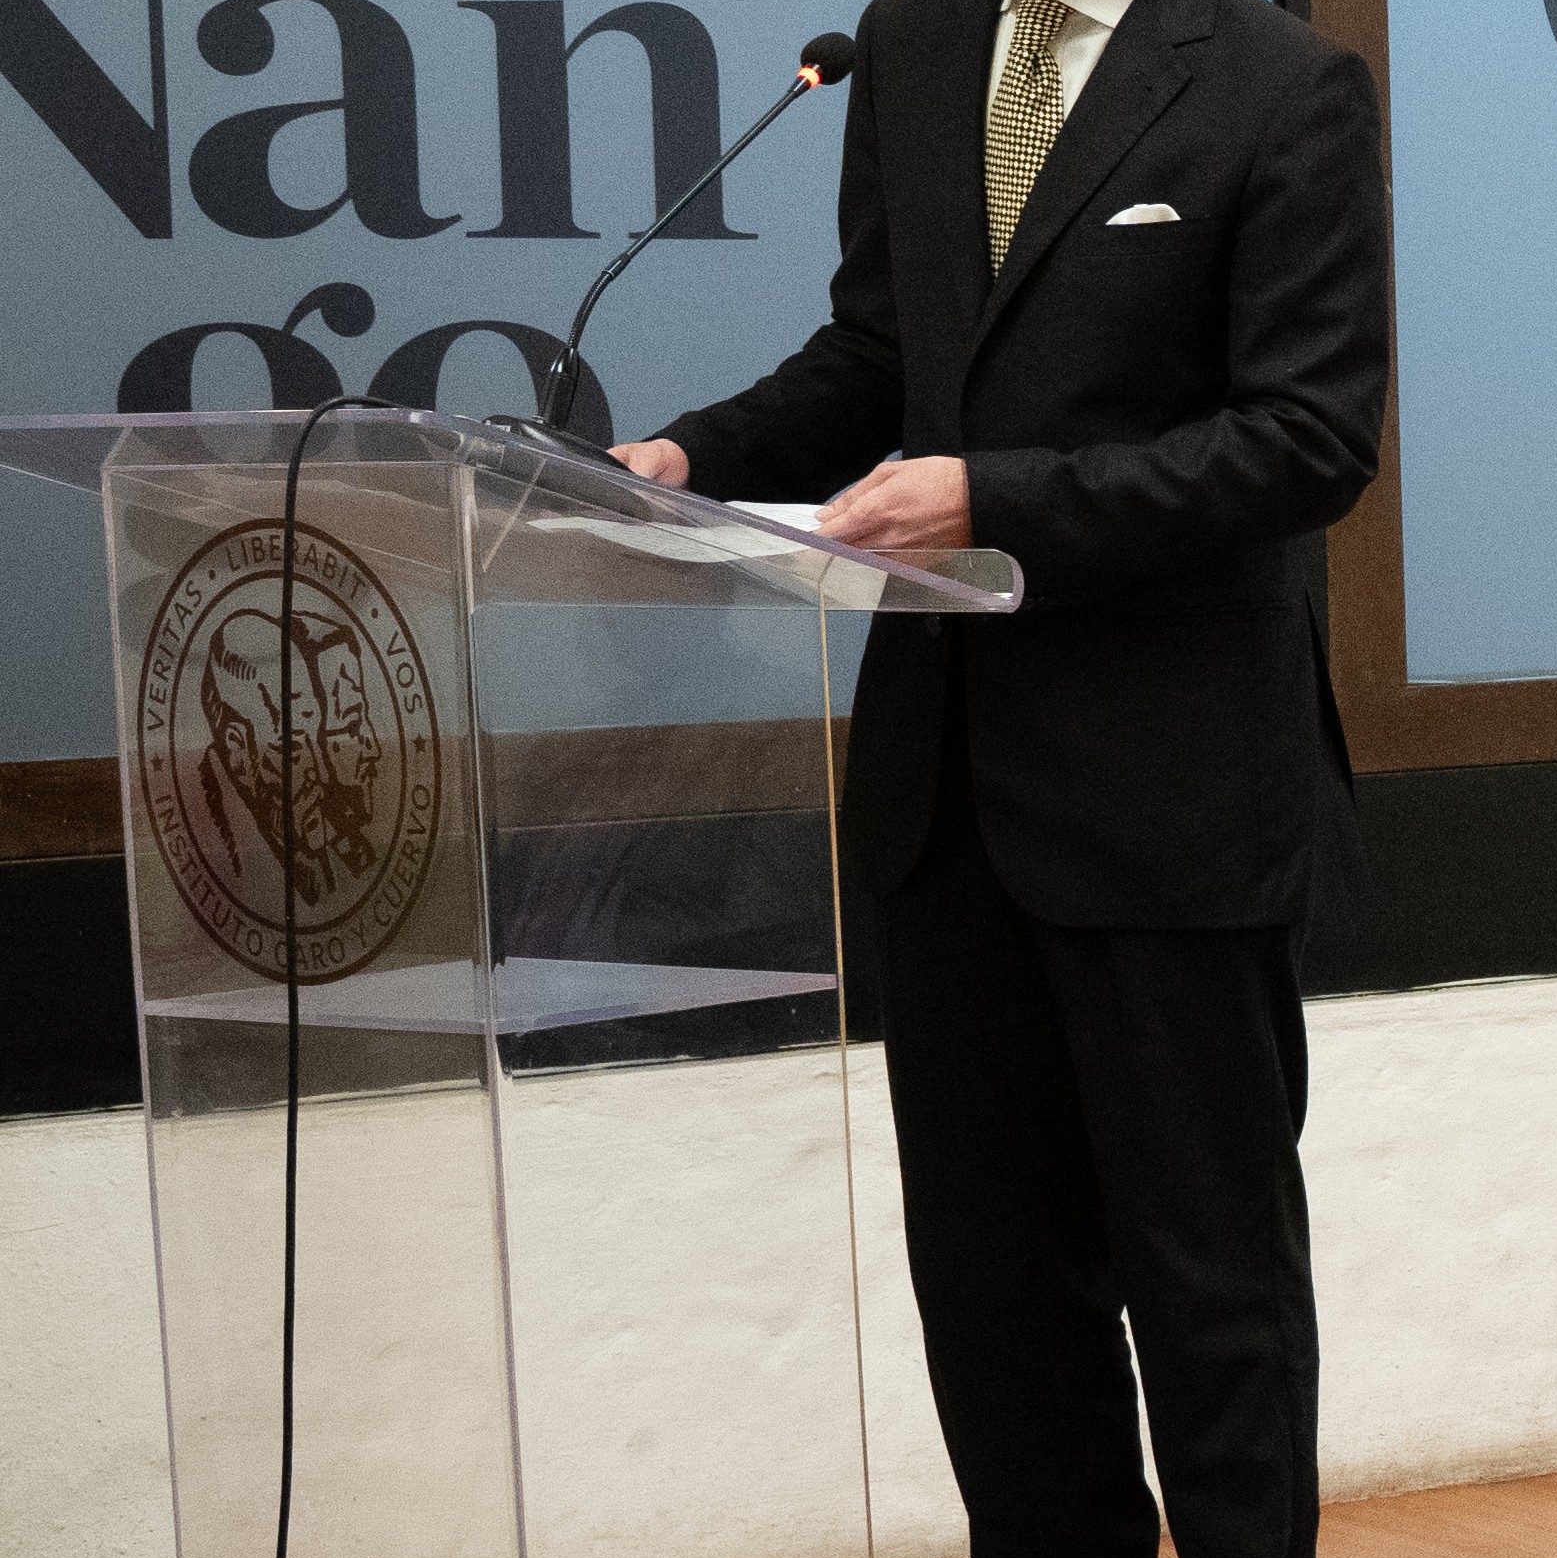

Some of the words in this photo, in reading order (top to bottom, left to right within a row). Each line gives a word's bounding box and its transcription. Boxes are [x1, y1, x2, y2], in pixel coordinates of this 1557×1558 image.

[146, 583, 202, 731] VERITAS
[385, 631, 423, 713] VOS
[153, 796, 265, 956] INSTITUTO
[350, 922, 370, 949] Y
[372, 783, 432, 928] CUERVO
